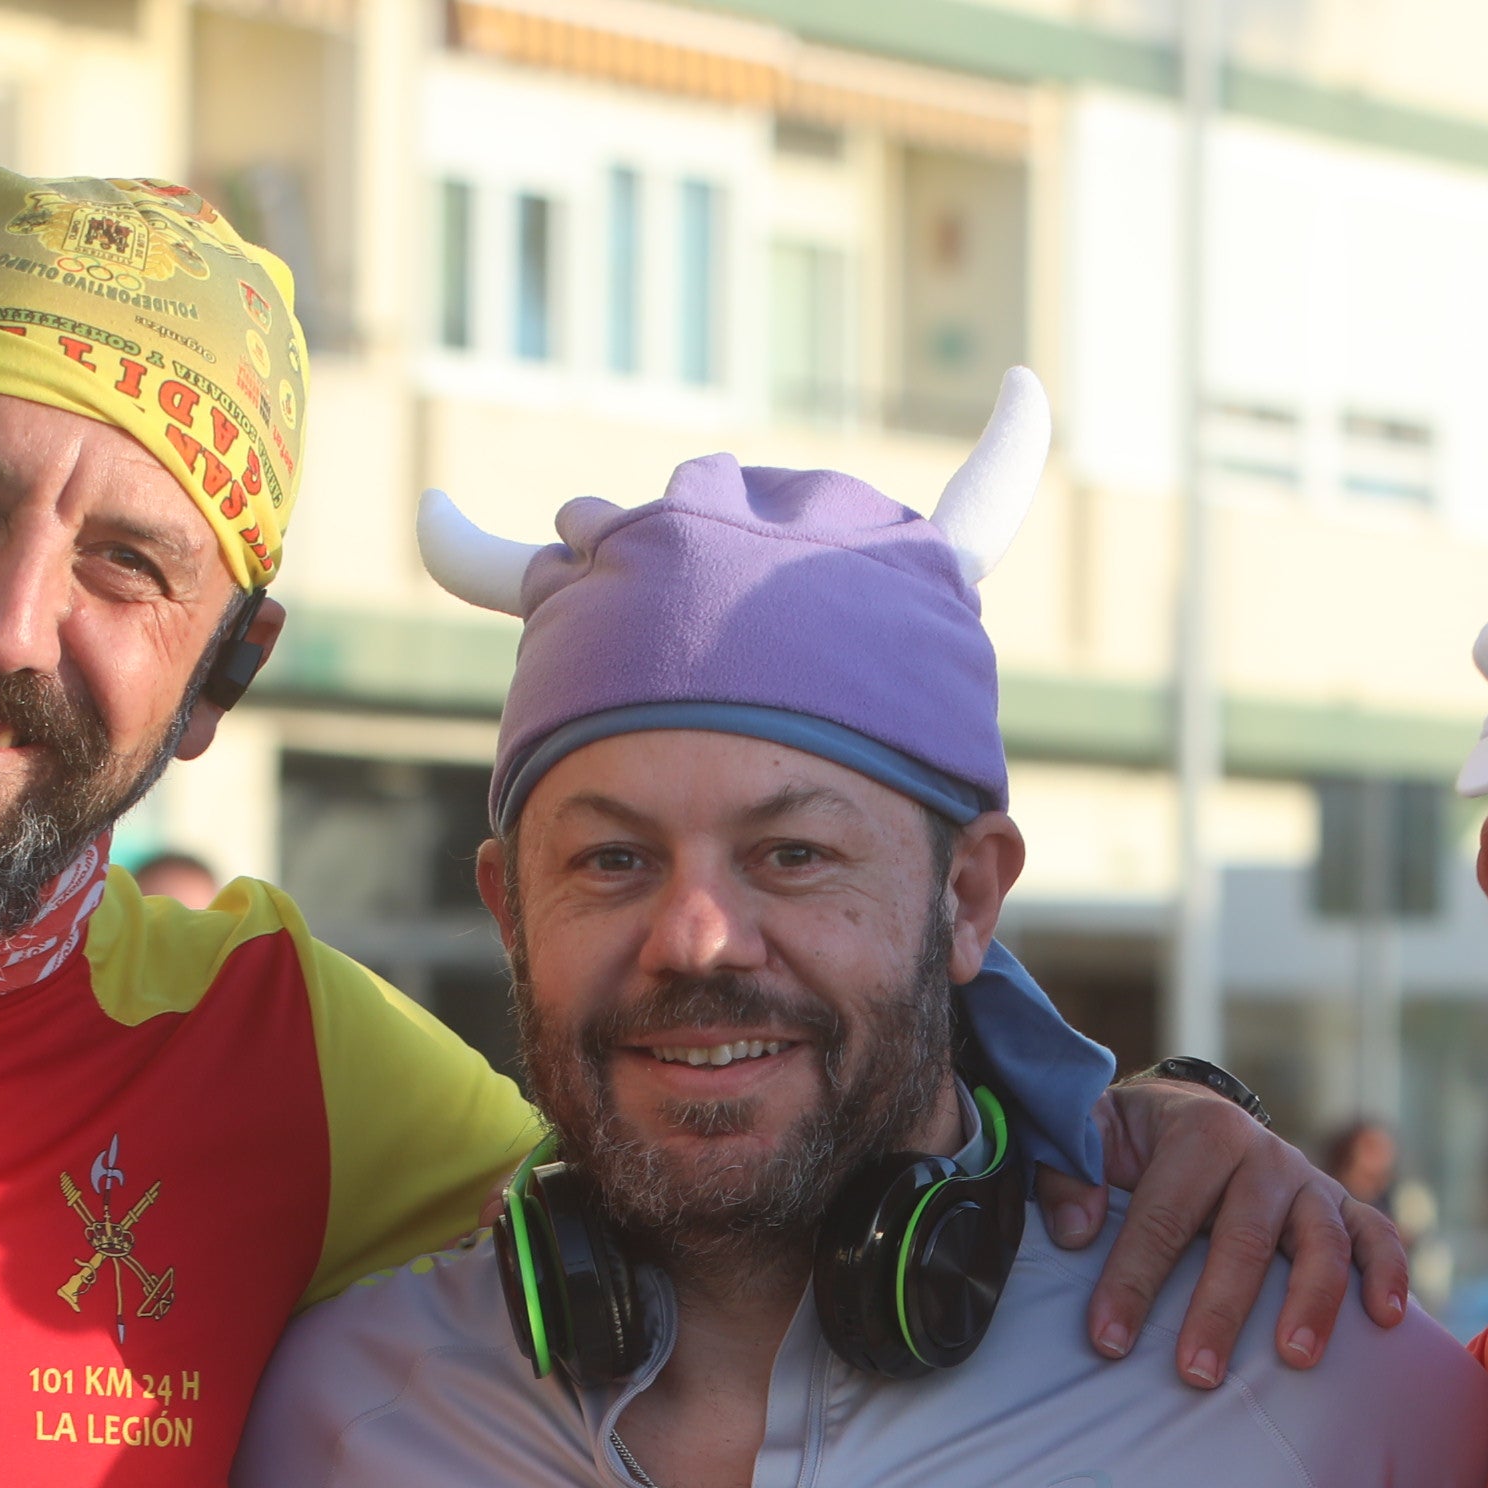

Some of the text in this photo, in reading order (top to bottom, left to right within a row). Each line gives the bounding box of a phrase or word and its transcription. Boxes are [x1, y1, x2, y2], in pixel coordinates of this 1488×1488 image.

[62, 274, 200, 320] POLIDEPORTIVO
[135, 315, 217, 364] Organiza:
[146, 350, 166, 370] Y
[172, 360, 258, 444] SOLIDARIA
[29, 1366, 199, 1406] 101 KM 24 H
[36, 1411, 192, 1447] LA LEGIÓN
